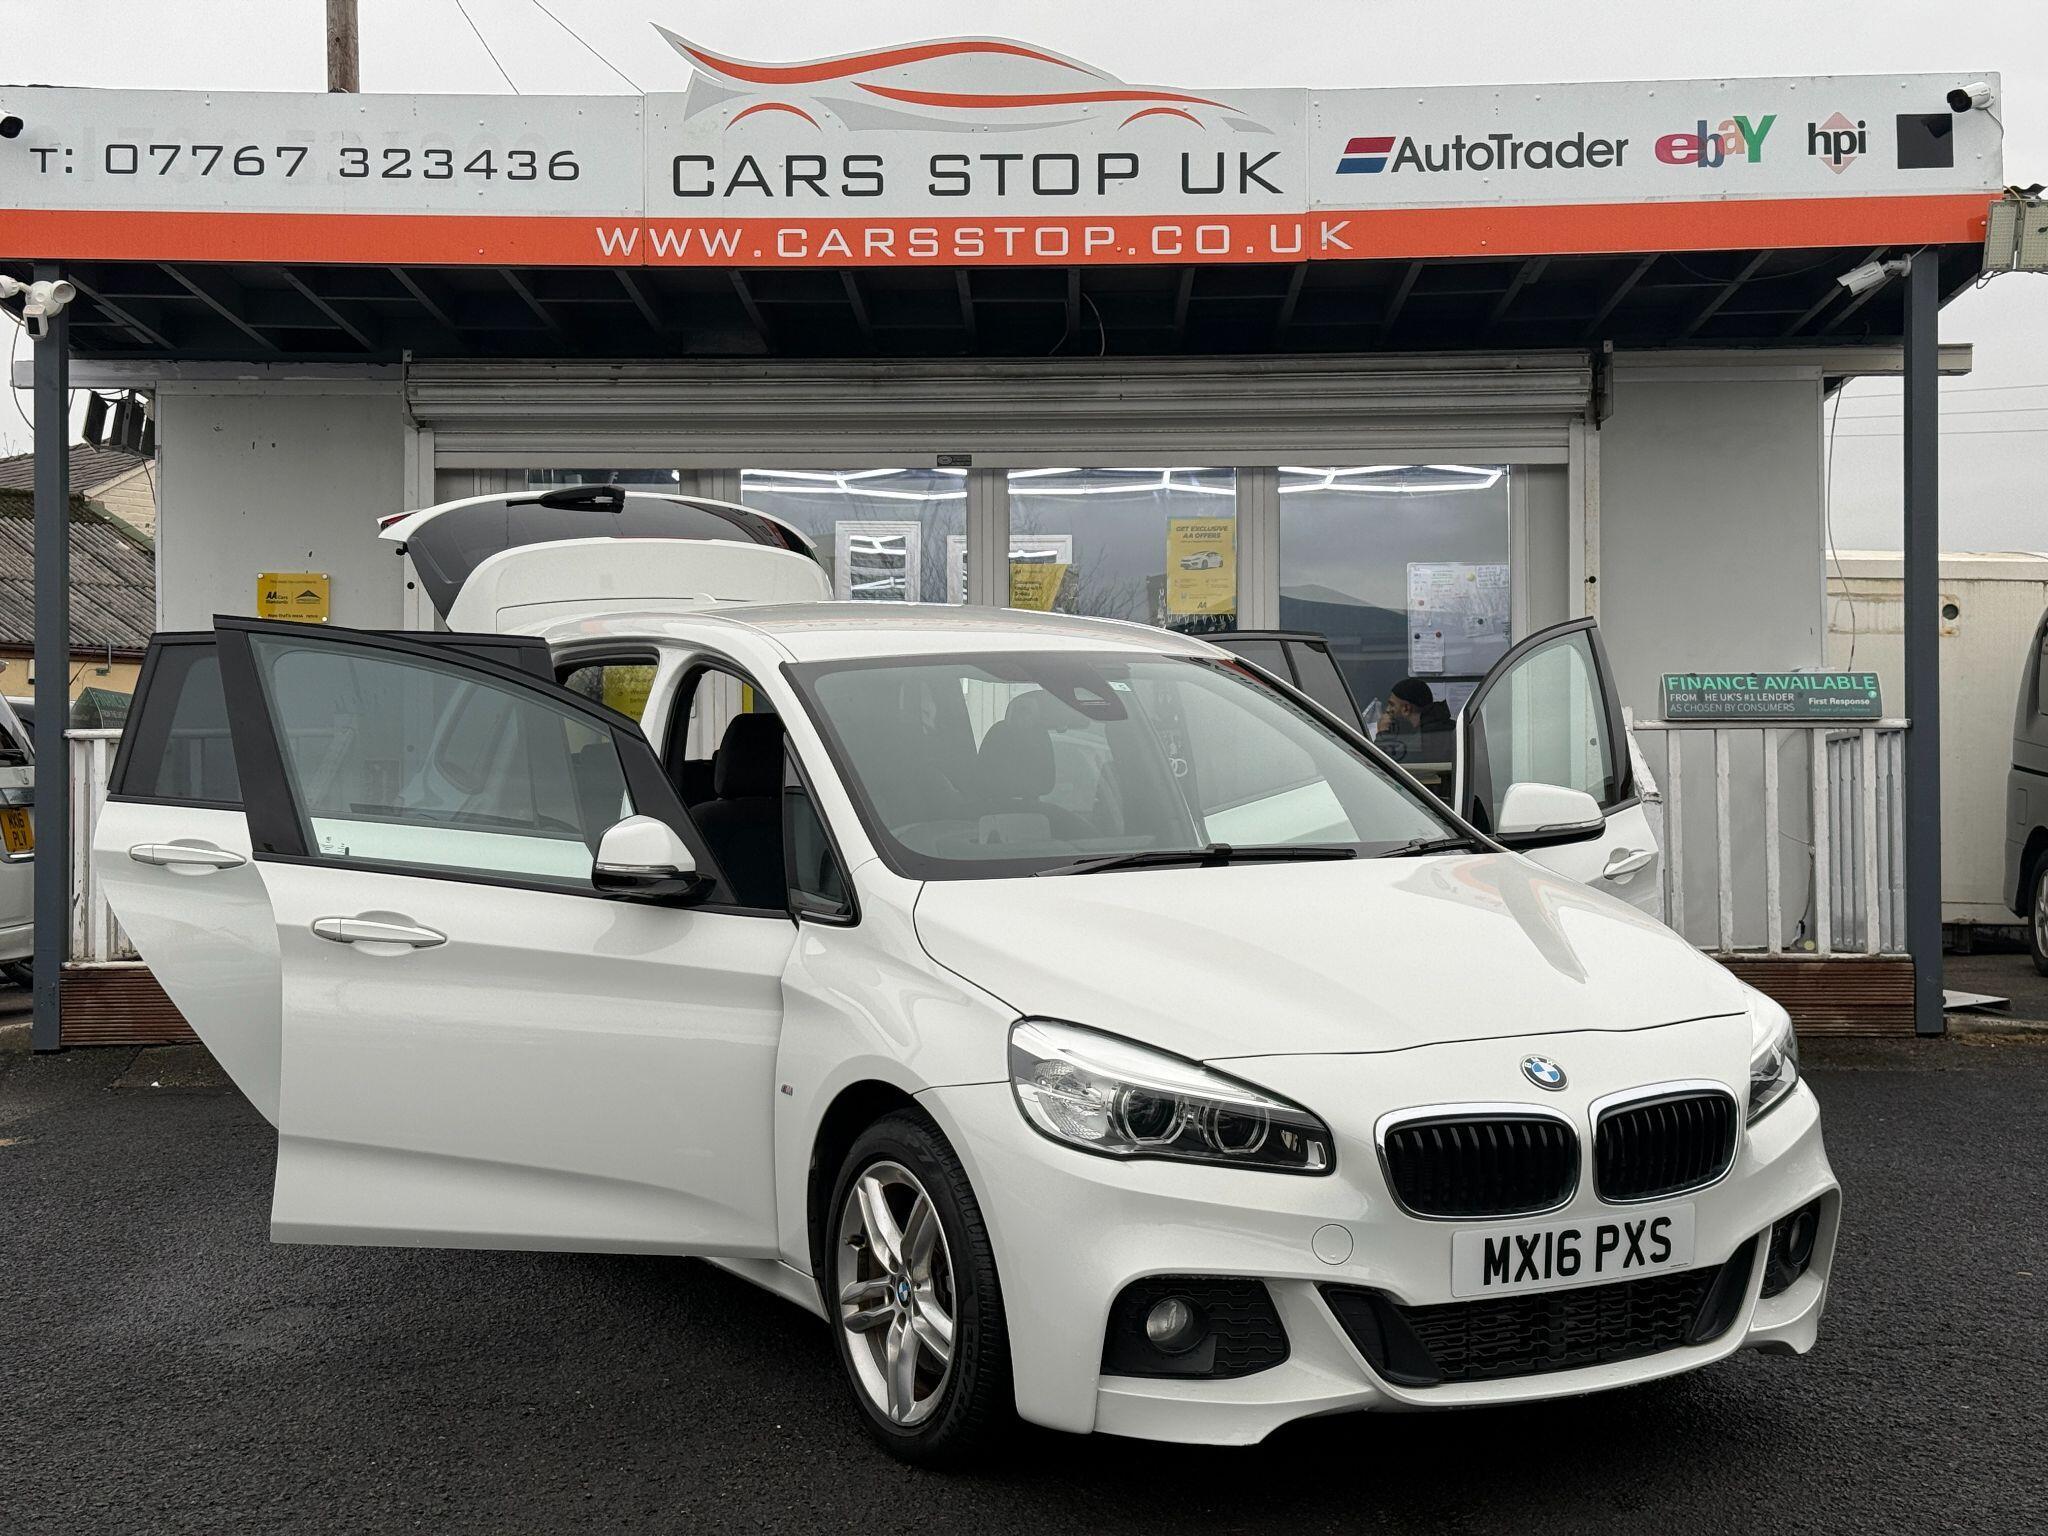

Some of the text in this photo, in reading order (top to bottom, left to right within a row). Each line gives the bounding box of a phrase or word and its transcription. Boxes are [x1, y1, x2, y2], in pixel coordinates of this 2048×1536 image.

[1391, 133, 1629, 173] AutoTrader
[1807, 119, 1867, 165] hpi
[29, 144, 580, 181] T: 07767 323436
[672, 151, 1284, 198] CARS STOP UK
[595, 220, 1355, 259] WWW.CARSSTOP.CO.UK
[265, 591, 278, 600] AA
[1667, 675, 1877, 691] FINANCE AVAILABLE
[1669, 693, 1697, 702] FROM
[1720, 692, 1742, 702] UK'S
[1743, 692, 1756, 702] #1
[1757, 692, 1795, 701] LENDER
[1808, 697, 1870, 706] First Response
[1670, 703, 1796, 712] AS CHOSEN BY CONSUMERS
[1483, 1216, 1672, 1286] MX16 PXS
